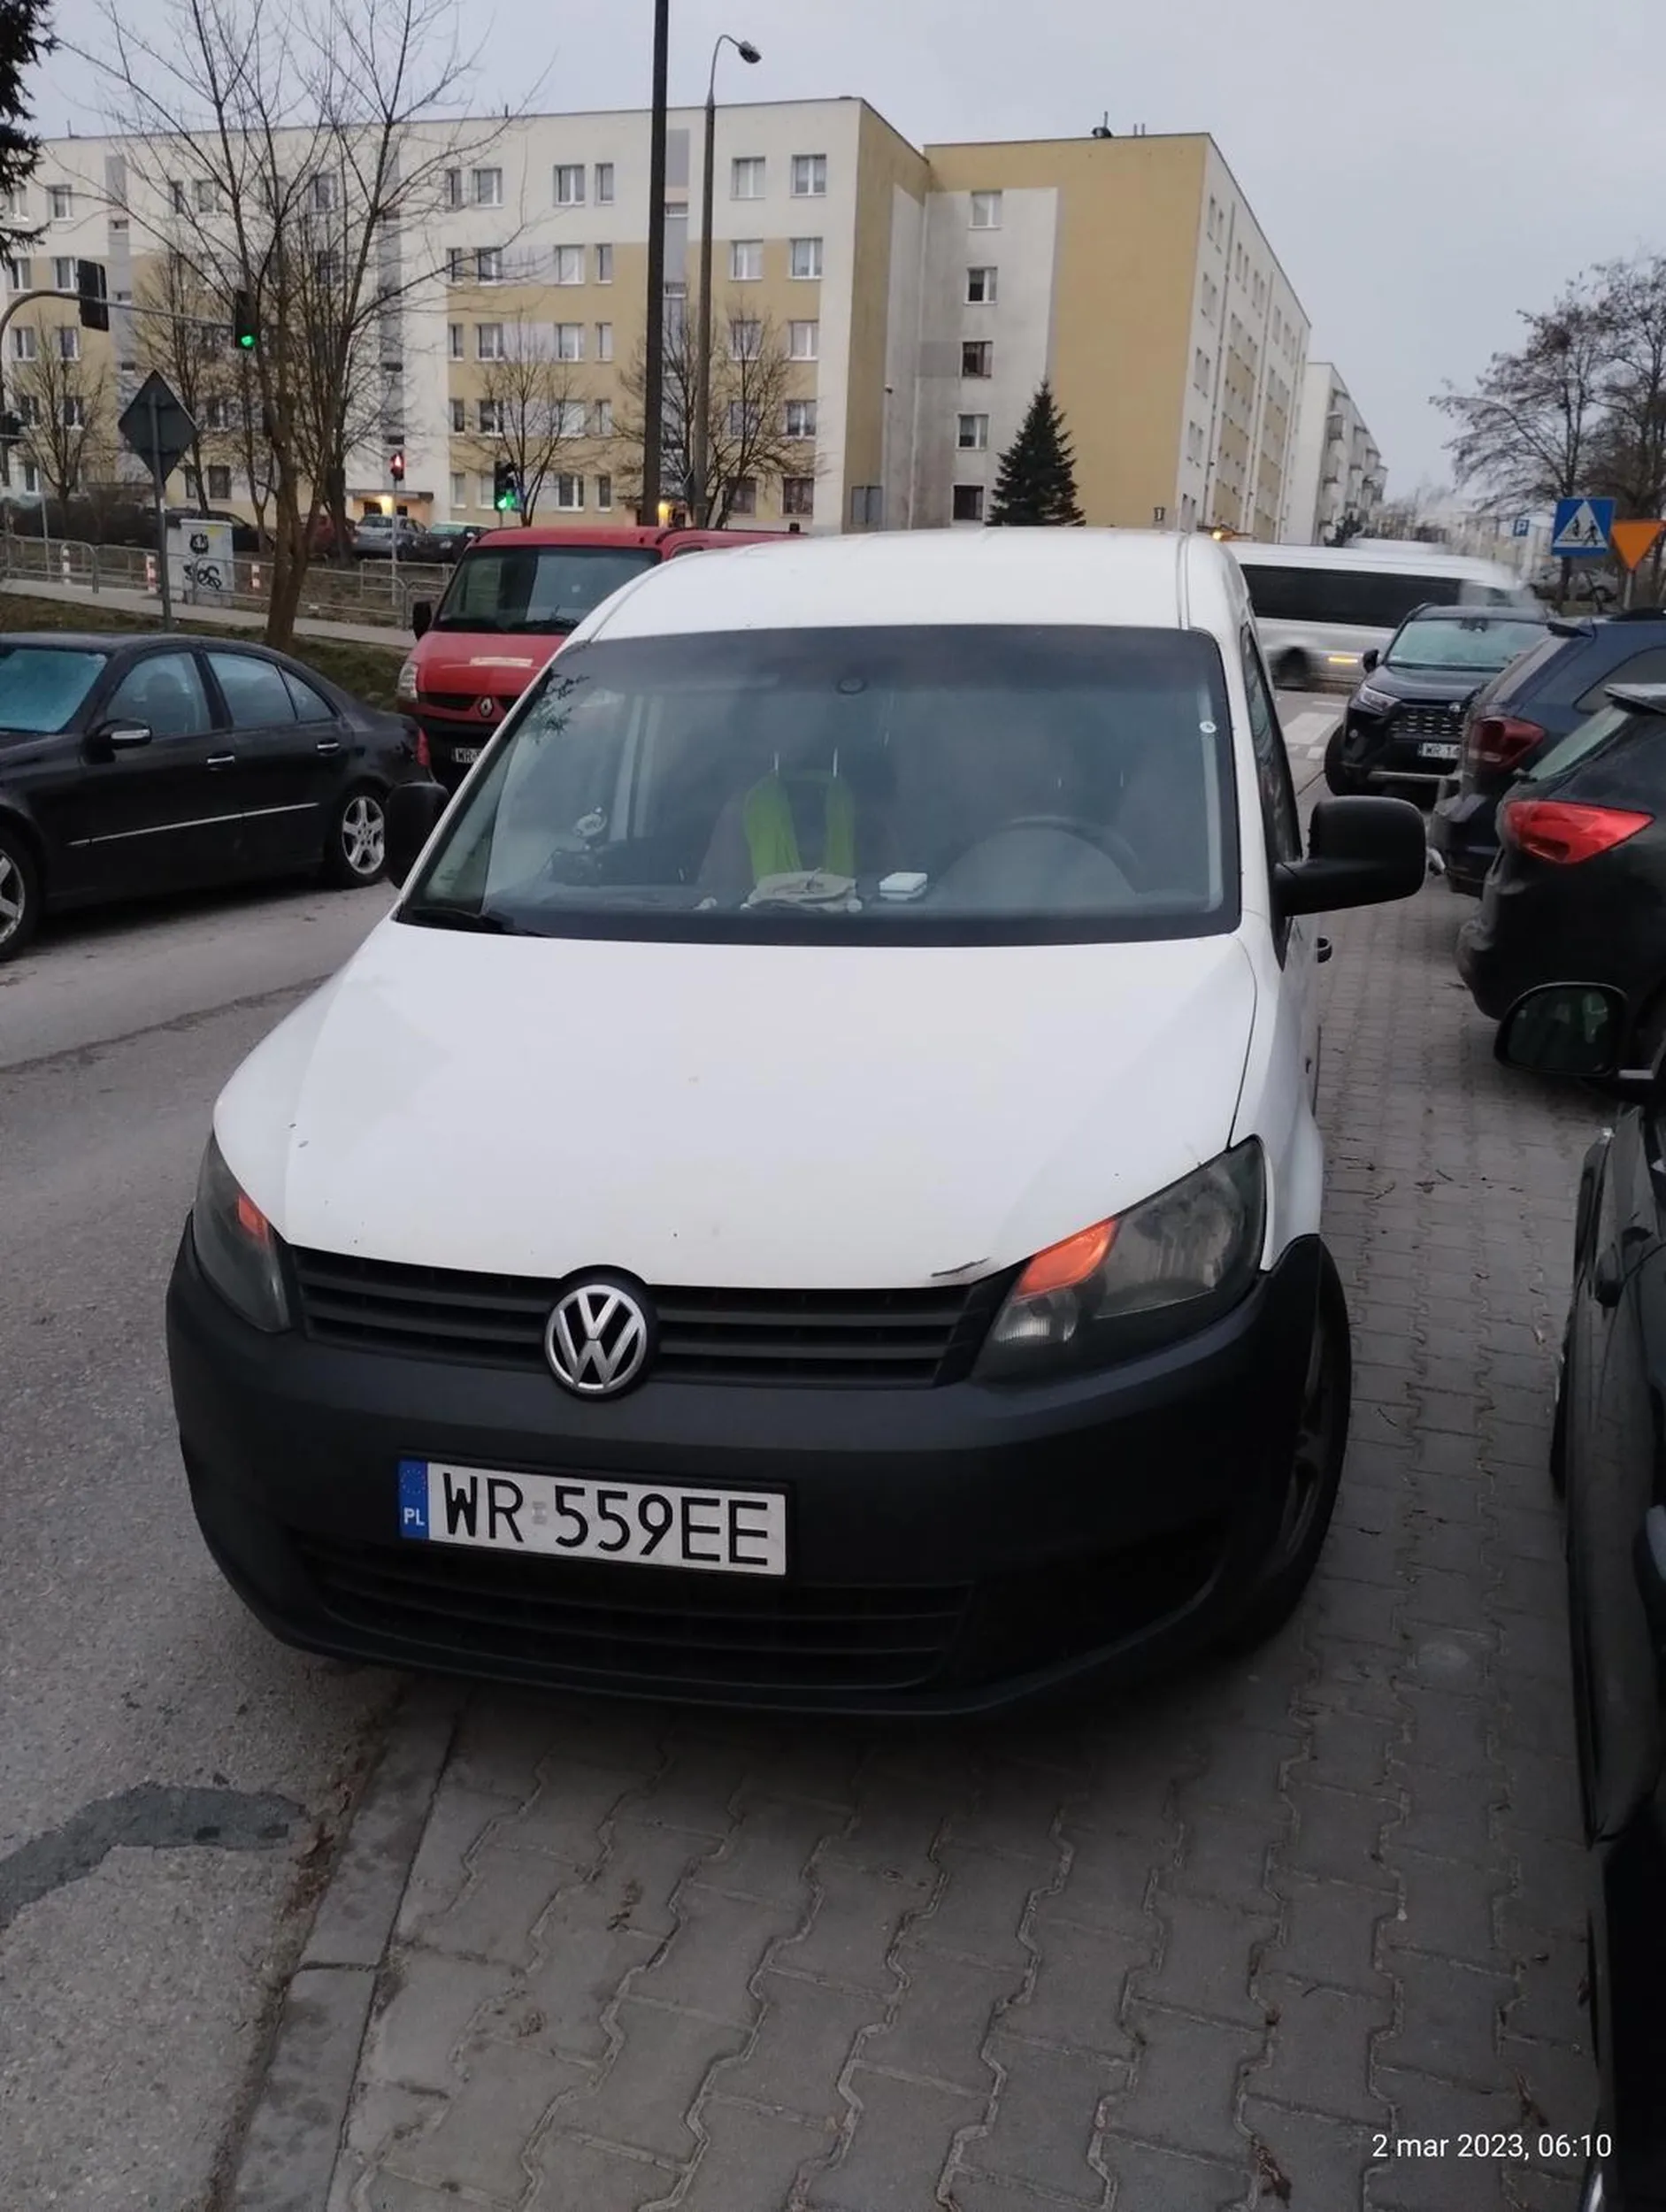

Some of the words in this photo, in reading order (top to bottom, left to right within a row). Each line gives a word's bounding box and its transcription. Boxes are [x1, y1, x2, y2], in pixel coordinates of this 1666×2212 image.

[403, 1507, 425, 1526] PL
[443, 1472, 524, 1542] WR
[555, 1485, 768, 1566] 559EE
